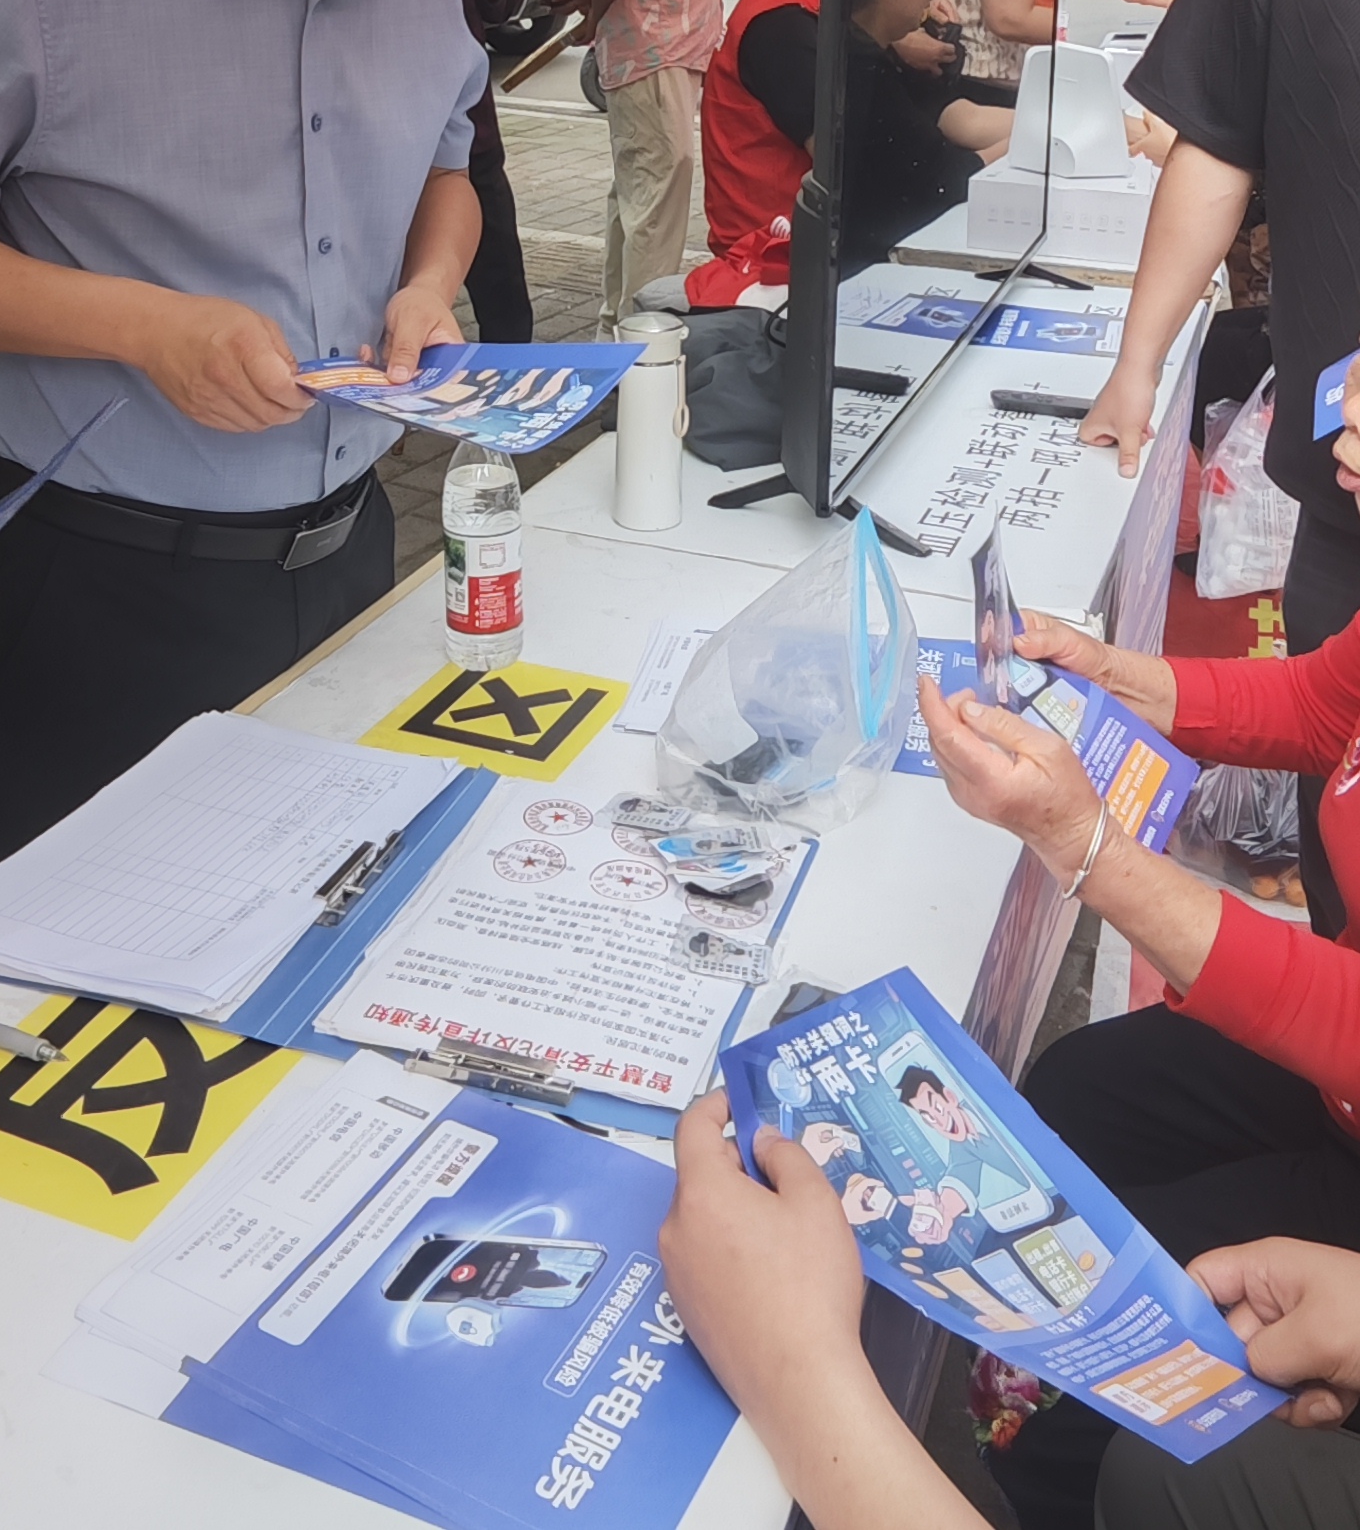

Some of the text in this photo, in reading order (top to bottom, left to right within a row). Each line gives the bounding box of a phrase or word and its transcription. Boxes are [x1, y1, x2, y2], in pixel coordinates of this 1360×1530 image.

[777, 1010, 869, 1069] 防诈关键词之
[553, 1258, 653, 1392] 有效降低被骗风险
